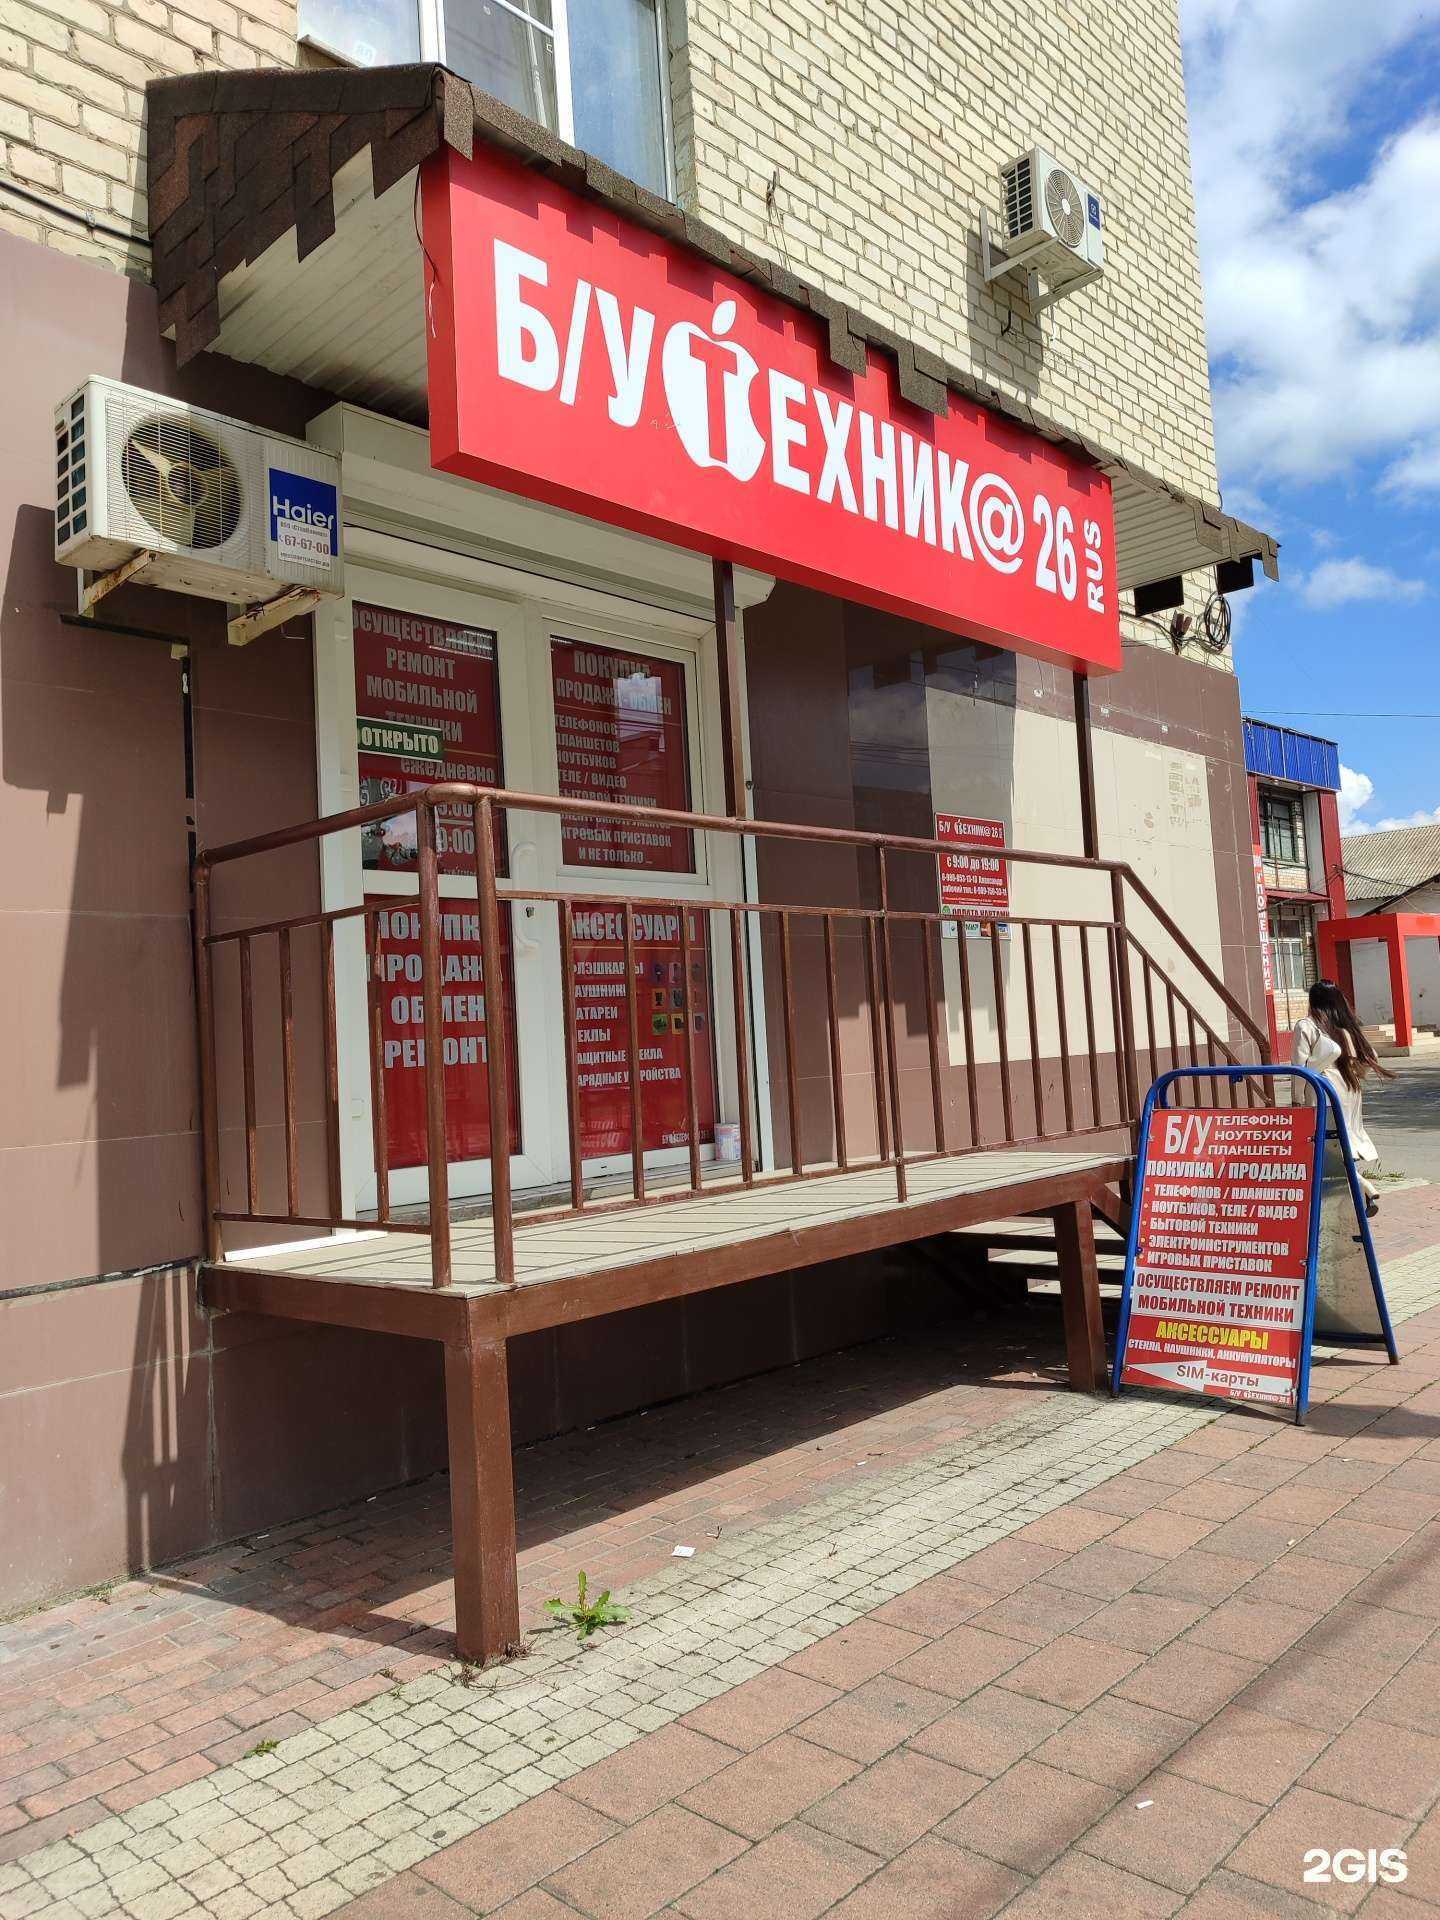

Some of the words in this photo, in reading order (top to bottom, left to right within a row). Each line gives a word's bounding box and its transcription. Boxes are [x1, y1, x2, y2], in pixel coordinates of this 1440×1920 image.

[494, 239, 655, 427] Б/У
[1033, 494, 1078, 601] 26
[272, 495, 335, 530] Haier
[284, 534, 329, 555] 67-67-00
[1083, 519, 1105, 614] RUS
[386, 647, 455, 680] РЕМОНТ
[366, 675, 478, 714] МОБИЛЬНОЙ
[361, 726, 439, 754] ОТКРЫТО
[591, 772, 627, 789] ВИДЕО
[614, 831, 672, 848] ПРИСТАВОК
[579, 847, 586, 859] И
[588, 848, 601, 861] НЕ
[981, 857, 1000, 871] 19:00
[1215, 1115, 1292, 1126] ТЕЛЕФОНЫ
[1165, 1115, 1213, 1154] Б/У
[1214, 1130, 1292, 1141] НОУТБУКИ
[1208, 1145, 1292, 1156] ПЛАНШЕТЫ
[1147, 1160, 1214, 1178] ПОКУПКА
[1229, 1163, 1307, 1181] ПРОДАЖА
[1154, 1184, 1221, 1199] ТЕЛЕФОНОВ
[1232, 1188, 1304, 1201] ПЛАНШЕТОВ
[1152, 1201, 1218, 1217] НОУТБУКОВ,
[1221, 1204, 1247, 1217] ТЕЛЕ
[1258, 1206, 1297, 1220] ВИДЕО
[1150, 1217, 1206, 1232] БЫТОВОЙ
[1209, 1221, 1258, 1235] ТЕХНИКИ
[1149, 1235, 1289, 1256] ЭЛЕКТРОИНСТРУМЕНТОВ
[1147, 1251, 1200, 1267] ИГРОВЫХ
[1203, 1255, 1272, 1272] ПРИСТАВОК
[1136, 1272, 1242, 1295] ОСУЩЕСТВЛЯЕМ
[1245, 1282, 1300, 1300] РЕМОНТ
[1138, 1294, 1225, 1316] МОБИЛЬНОЙ
[1229, 1302, 1294, 1323] ТЕХНИКИ
[1156, 1321, 1269, 1349] АКСЕССУАРЫ
[1217, 1349, 1296, 1369] АККУМУЛЯТОРЫ
[1176, 1364, 1260, 1387] SIM-карты
